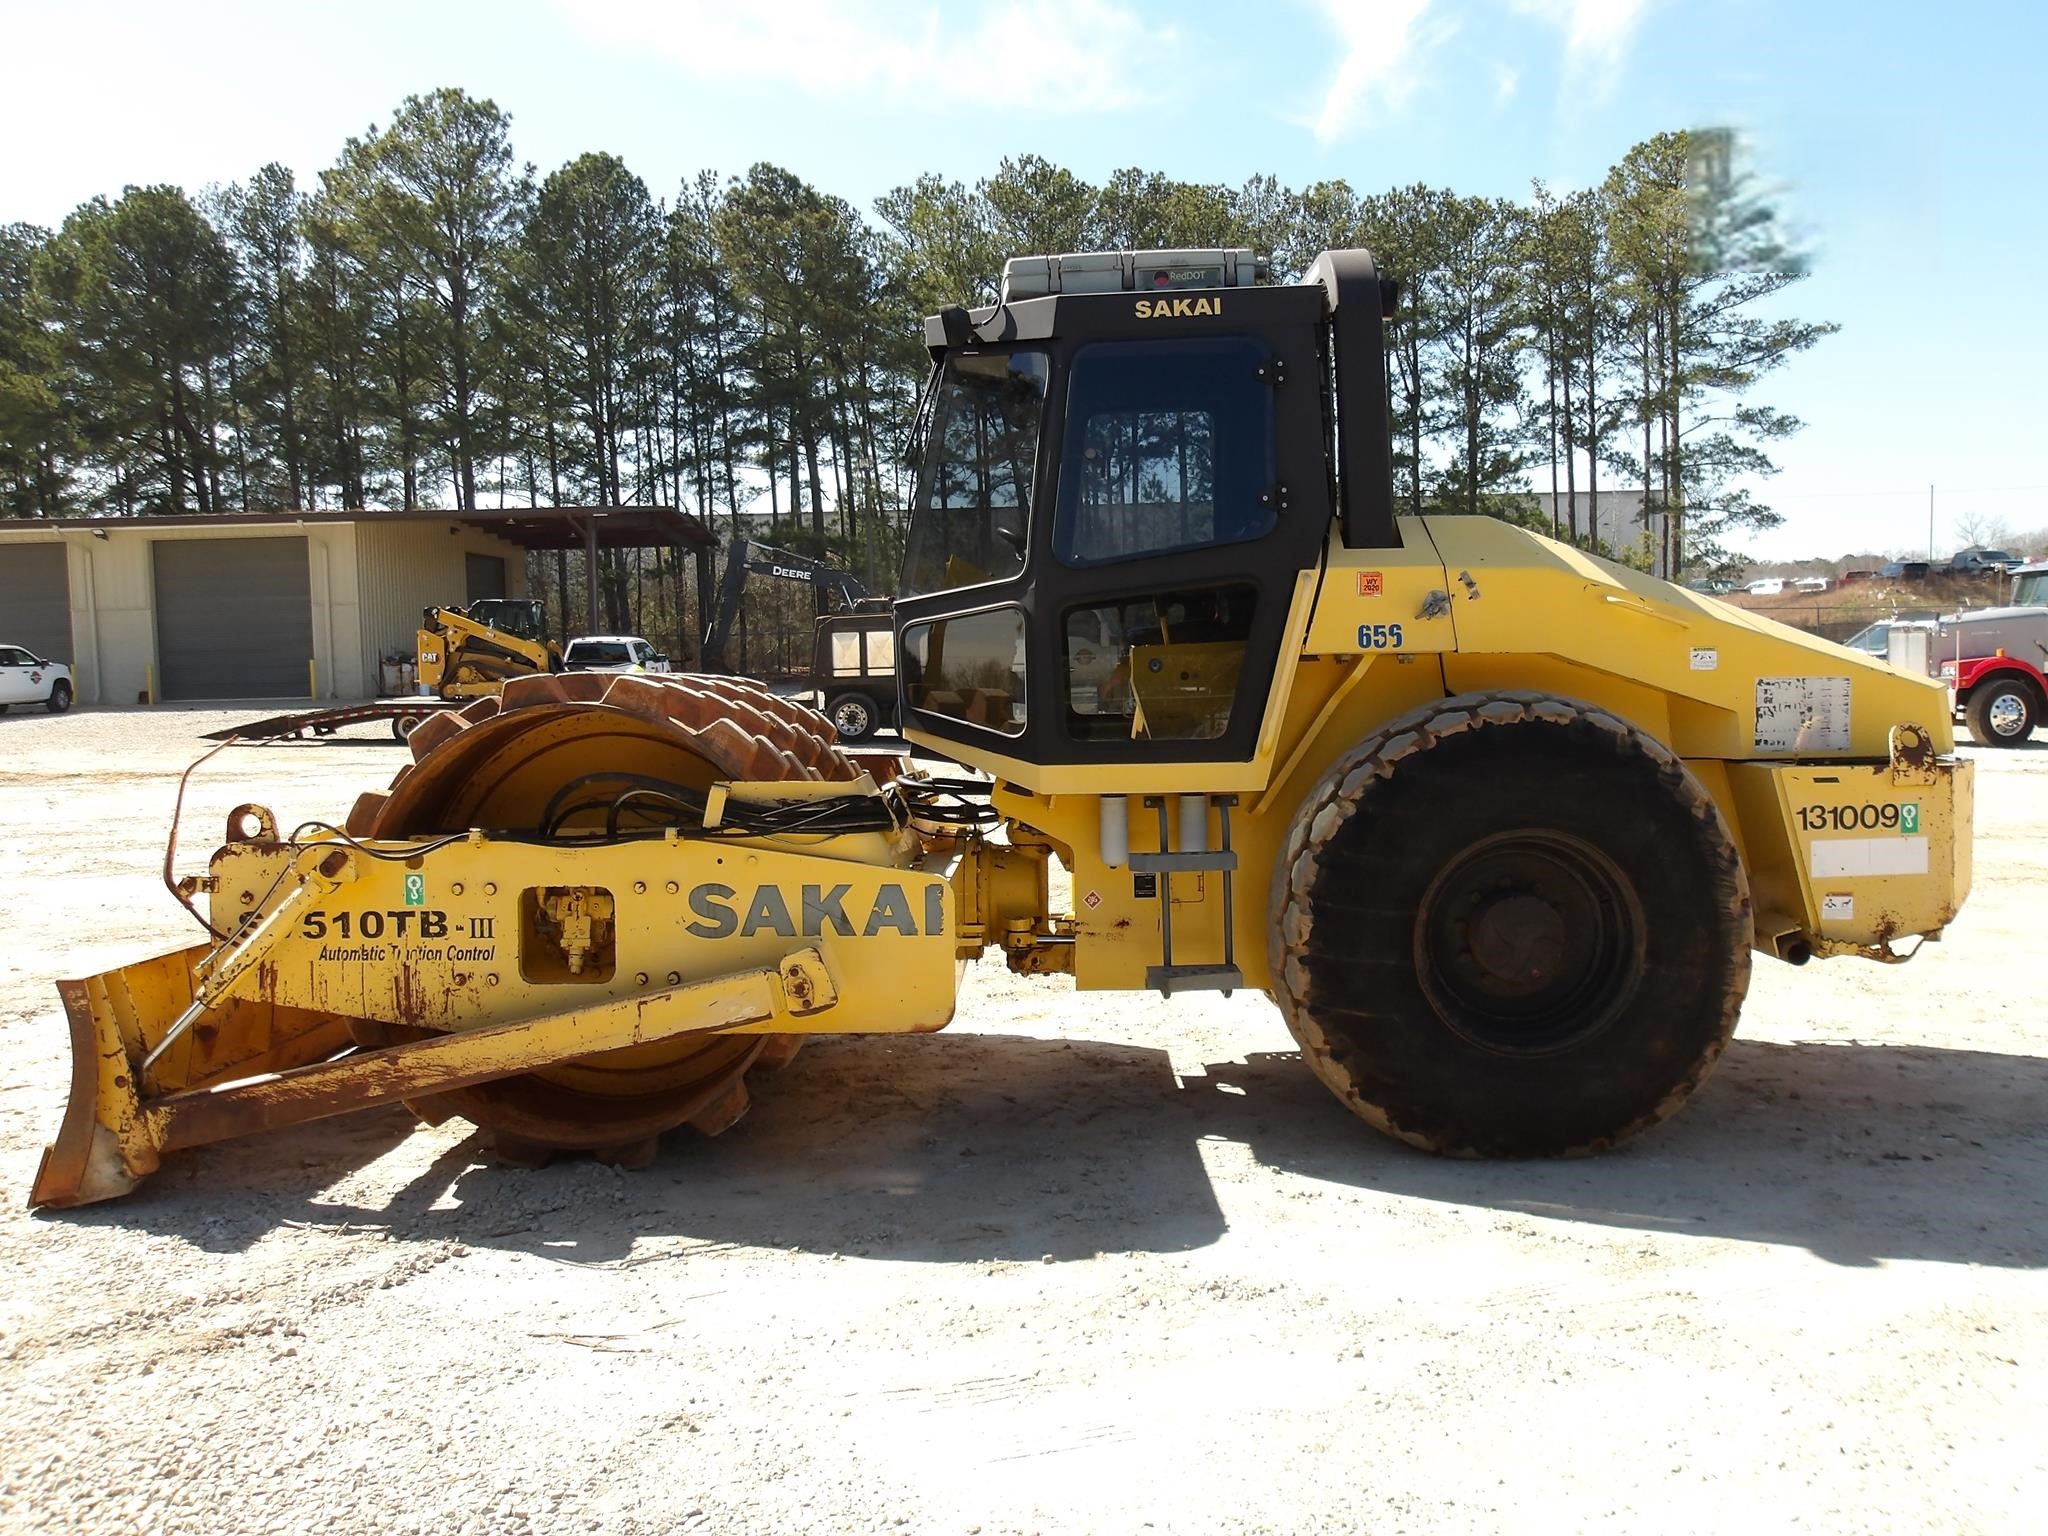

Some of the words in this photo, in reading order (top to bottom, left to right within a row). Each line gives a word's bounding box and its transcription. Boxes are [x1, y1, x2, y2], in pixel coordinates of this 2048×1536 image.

[1169, 270, 1206, 281] RedDOT
[1134, 297, 1222, 320] SAKAI
[772, 565, 812, 580] DEERE
[421, 652, 438, 663] CAT
[1796, 803, 1900, 831] 131009
[685, 883, 944, 939] SAKAI
[319, 945, 385, 962] Automatic
[446, 944, 495, 961] Control
